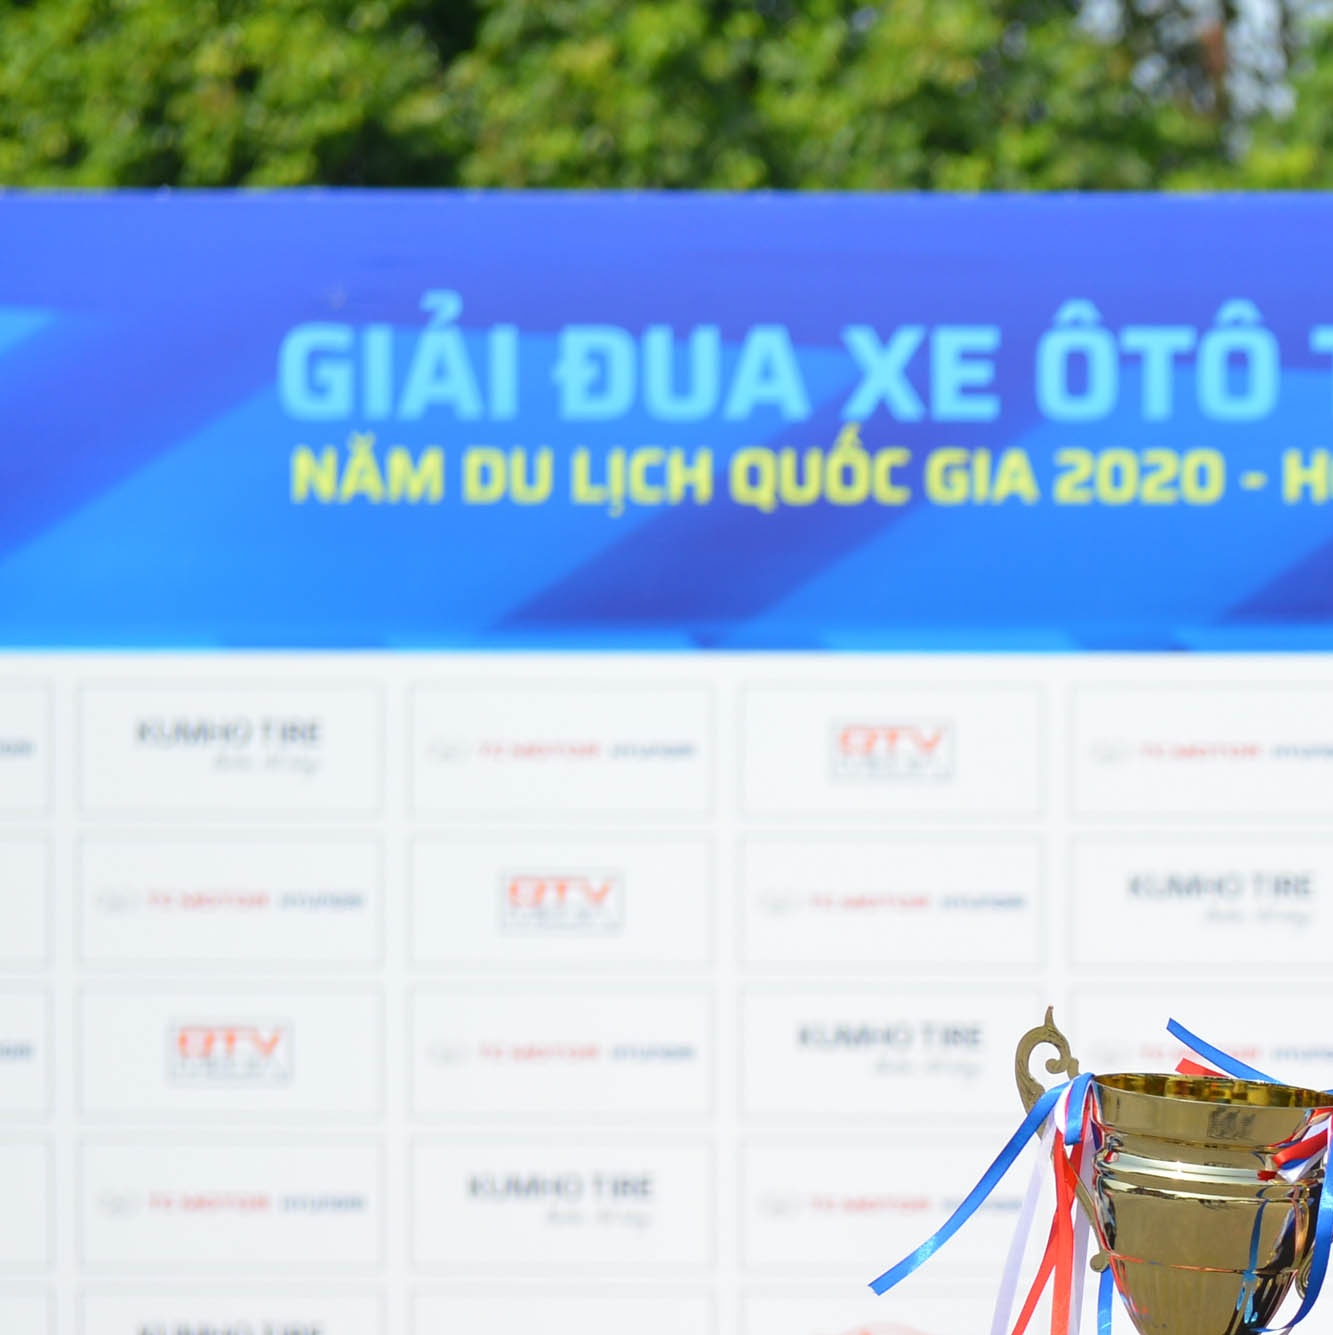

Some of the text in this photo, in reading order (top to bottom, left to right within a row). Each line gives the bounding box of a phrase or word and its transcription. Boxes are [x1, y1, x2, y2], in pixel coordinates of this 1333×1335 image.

[279, 290, 520, 420] GIẢI
[552, 324, 812, 420] ĐUA
[842, 324, 1001, 421] XE
[1036, 298, 1279, 422] ÔTÔ
[290, 432, 444, 504] NĂM
[462, 446, 552, 504] DU
[572, 446, 713, 516] LỊCH
[730, 422, 910, 513] QUỐC
[925, 448, 1040, 504] GIA
[1052, 448, 1225, 504] 2020
